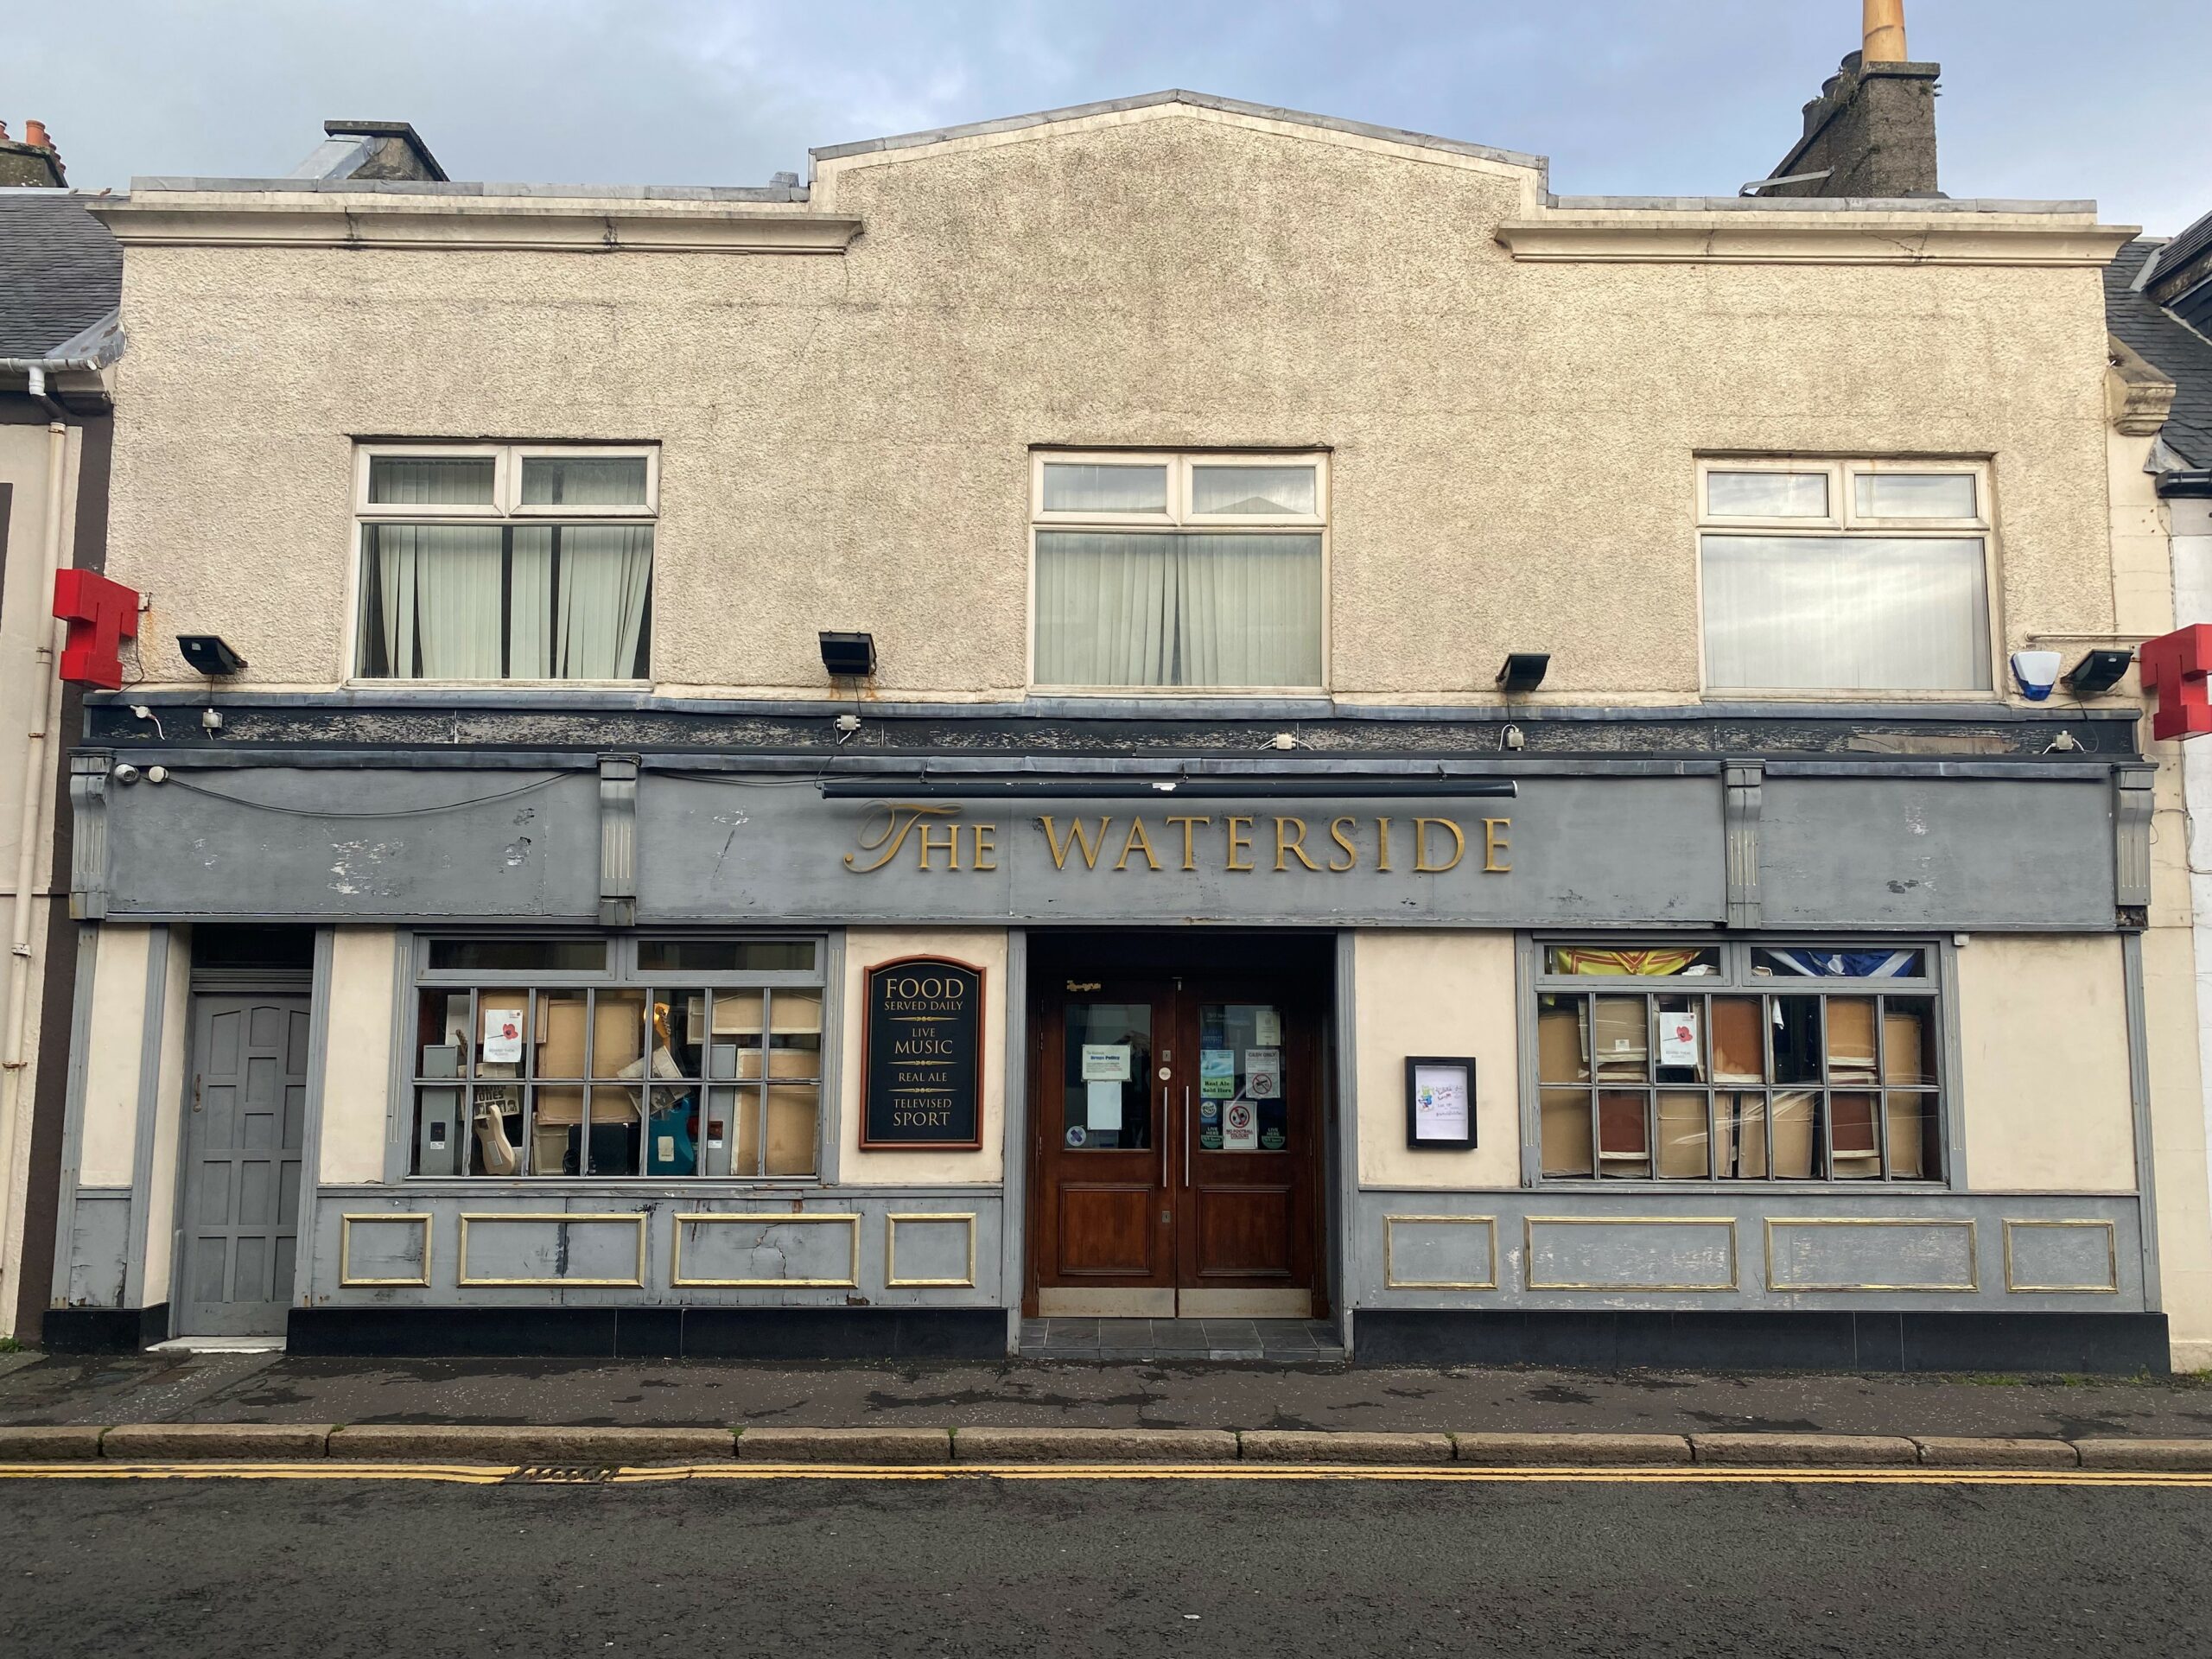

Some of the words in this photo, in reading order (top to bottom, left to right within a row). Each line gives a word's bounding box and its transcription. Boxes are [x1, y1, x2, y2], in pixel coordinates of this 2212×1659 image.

[843, 800, 996, 873] THE
[1038, 815, 1515, 873] WATERSIDE
[885, 978, 964, 999] FOOD
[884, 1001, 926, 1011] SERVED
[930, 1001, 964, 1011] DAILY
[912, 1028, 936, 1038] LIVE
[894, 1040, 953, 1054] MUSIC
[899, 1072, 925, 1082] REAL
[928, 1072, 948, 1082] ALE
[893, 1098, 952, 1109] TELEVISED
[893, 1111, 950, 1126] SPORT
